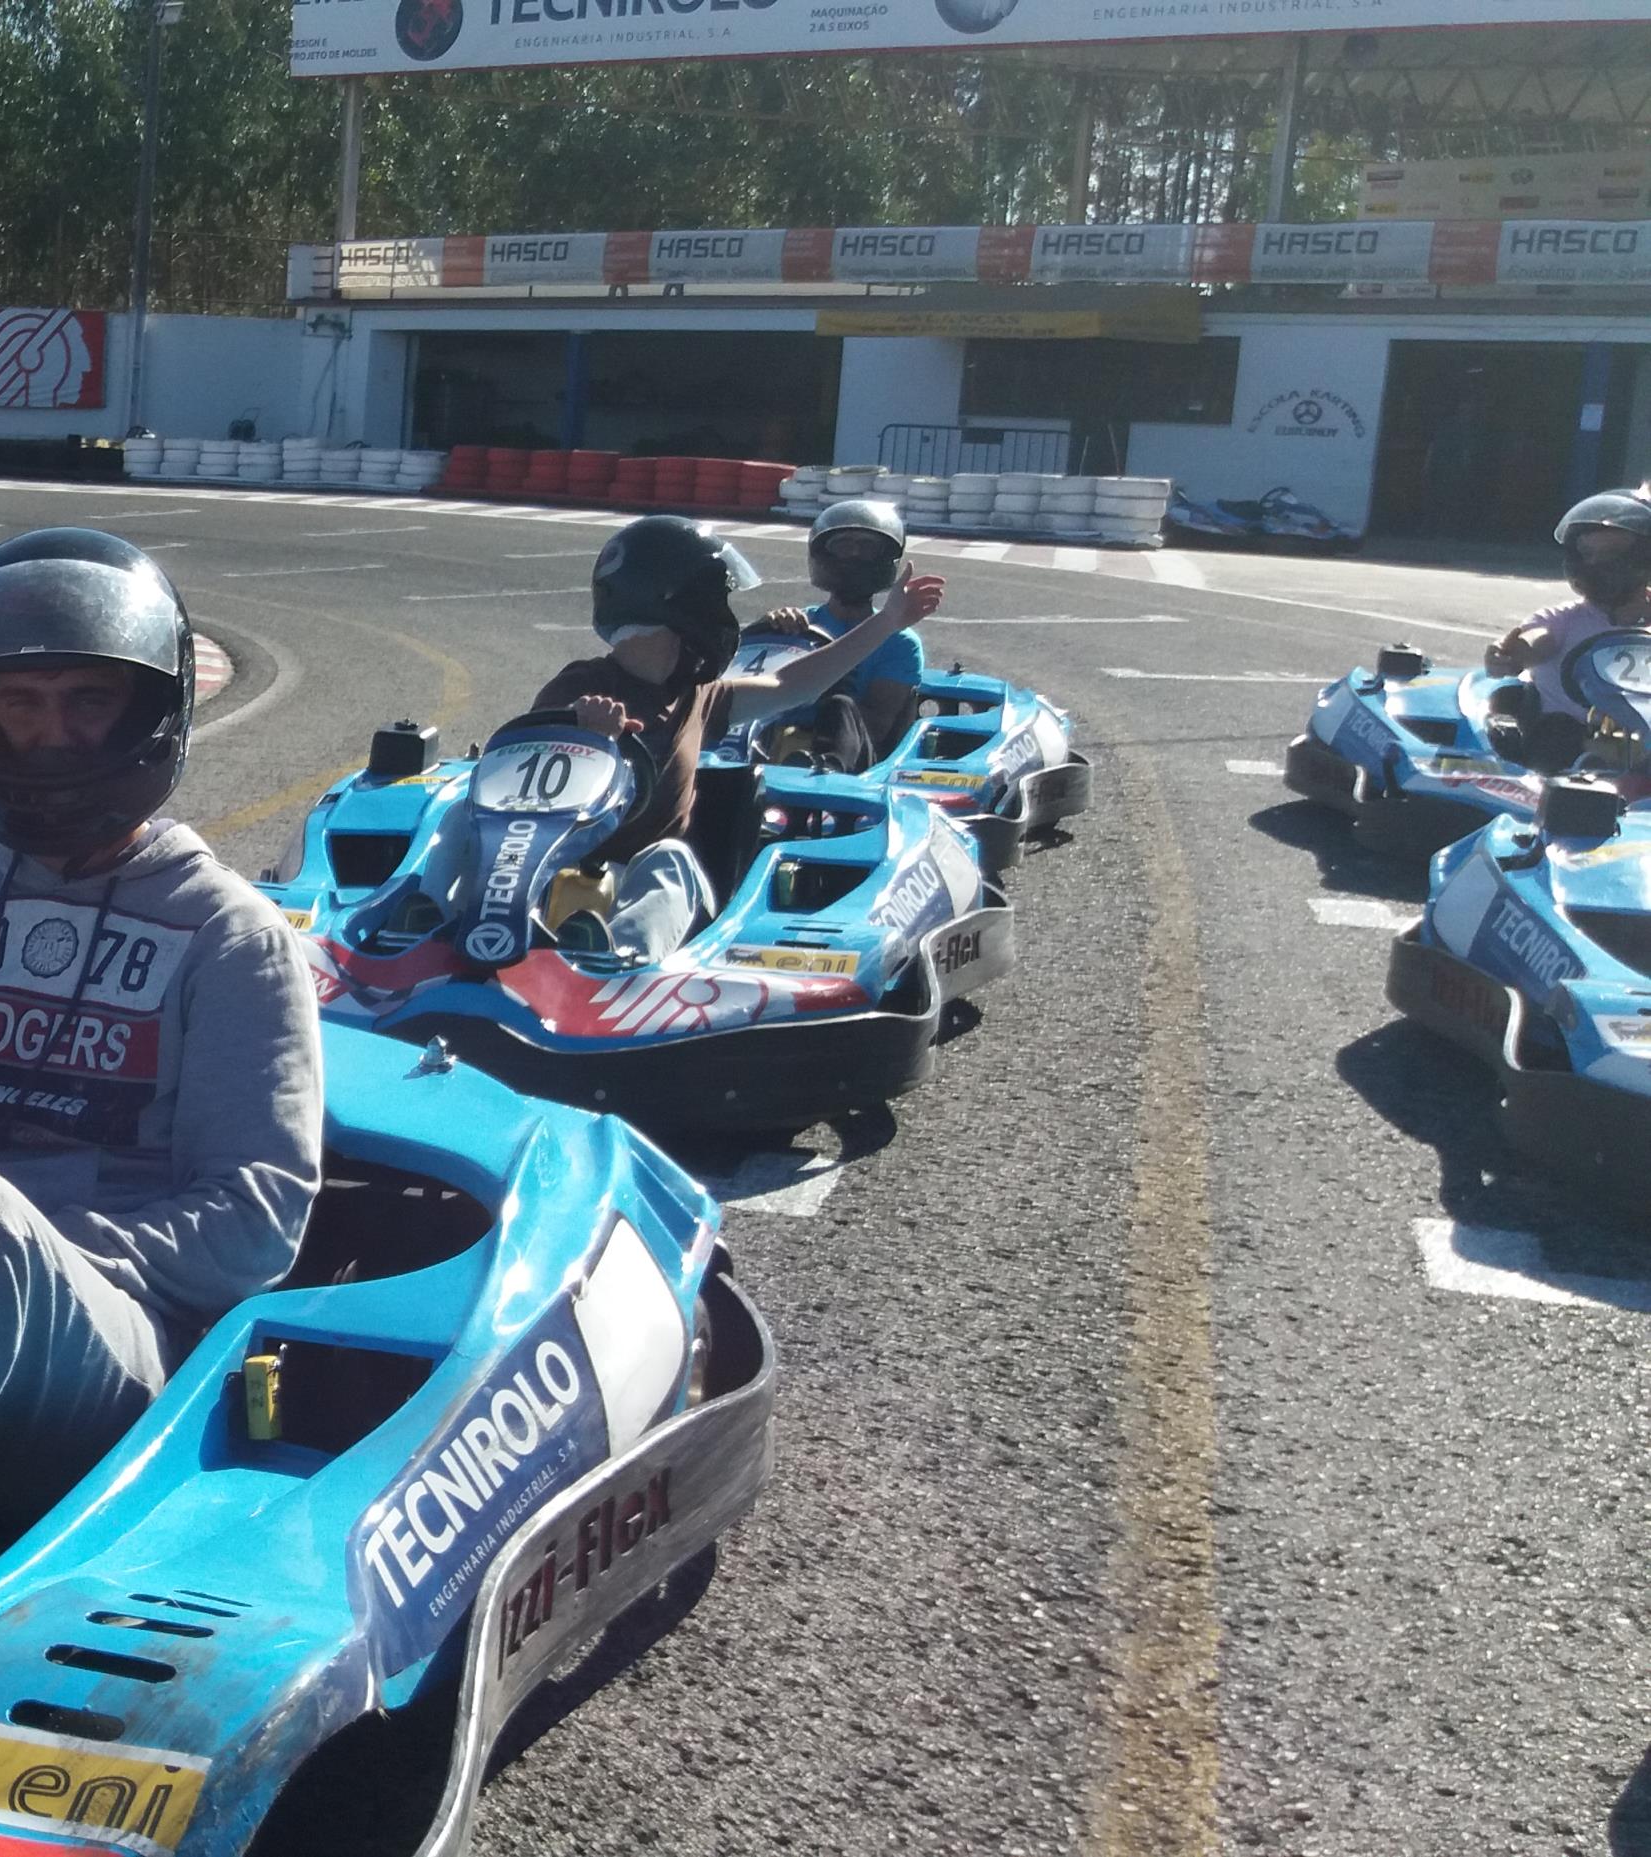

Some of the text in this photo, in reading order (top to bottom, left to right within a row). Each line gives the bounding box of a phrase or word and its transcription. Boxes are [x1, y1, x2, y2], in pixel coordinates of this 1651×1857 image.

[1091, 3, 1209, 20] ENGENHARIA
[809, 23, 816, 33] 2
[817, 22, 826, 32] A
[837, 20, 870, 31] EIXOS
[342, 48, 378, 58] MOLDES
[514, 35, 603, 49] ENGENHARIA
[490, 240, 569, 263] HASCO
[657, 236, 744, 259] HASCO
[840, 234, 936, 257] HASCO
[1041, 232, 1146, 256] HASCO
[1262, 230, 1380, 255] HASCO
[1510, 229, 1639, 255] HASCO
[341, 245, 411, 266] HASCO
[743, 650, 768, 676] 4
[1614, 652, 1651, 682] 2
[516, 752, 572, 800] 10
[479, 820, 537, 920] TECNIROLO
[86, 928, 157, 992] 78
[776, 955, 848, 973] eni
[365, 1340, 580, 1608] TECNIROLO
[429, 1533, 497, 1618] ENGENHARIA
[8, 1764, 182, 1840] eni
